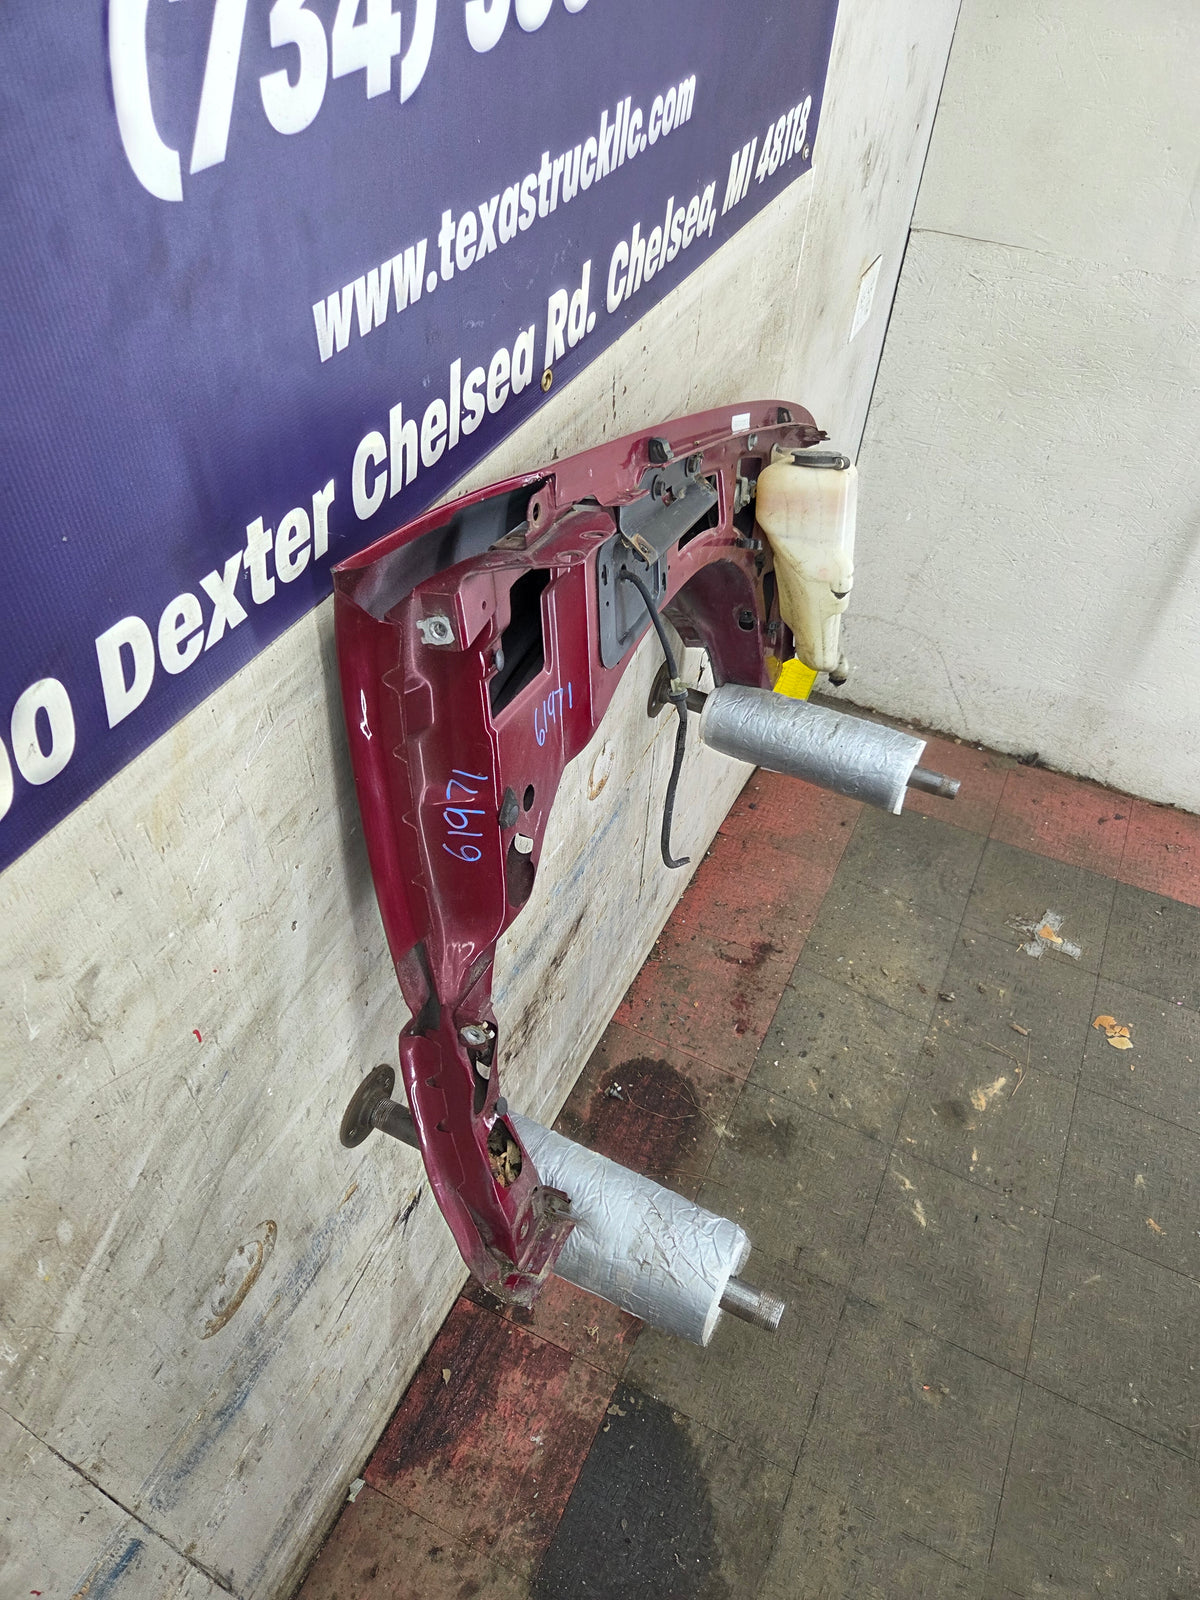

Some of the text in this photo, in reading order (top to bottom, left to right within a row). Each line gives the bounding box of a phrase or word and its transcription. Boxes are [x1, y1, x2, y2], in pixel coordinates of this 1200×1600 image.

[312, 73, 697, 363] www.texastruckllc.com
[0, 94, 812, 822] 0 Dexter Chelsea Rd. Chelsea, MI 48118
[534, 682, 573, 747] 61971
[443, 769, 488, 862] 61971
